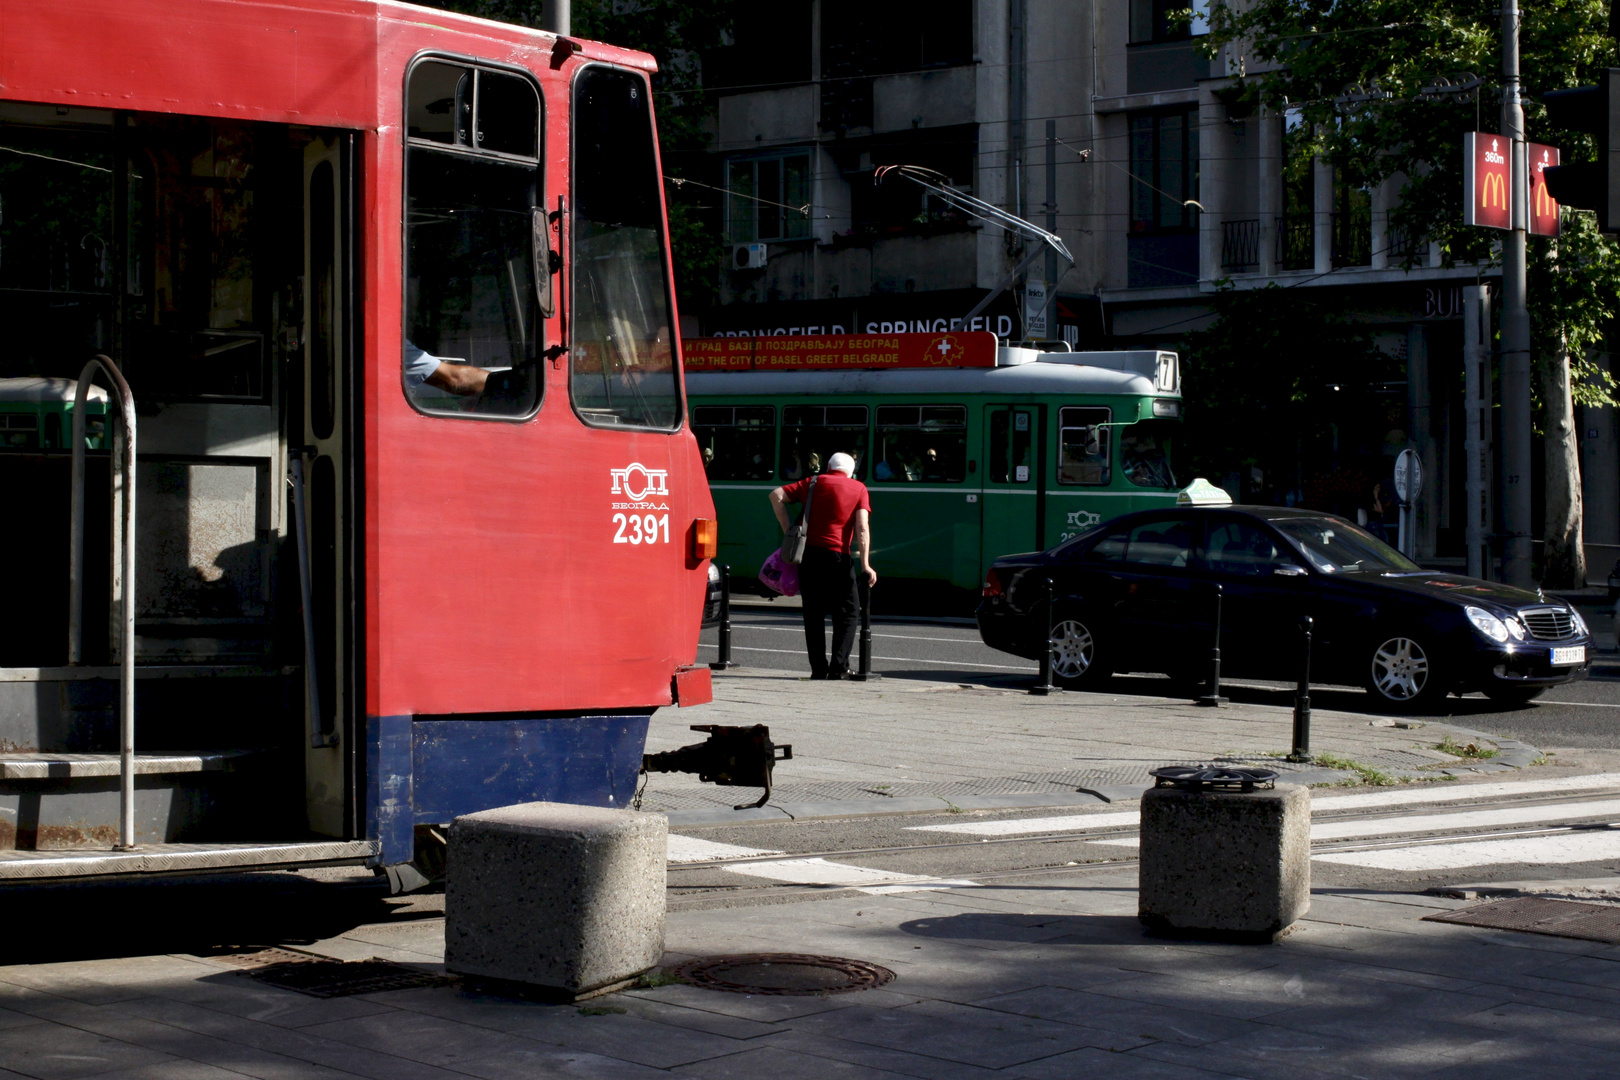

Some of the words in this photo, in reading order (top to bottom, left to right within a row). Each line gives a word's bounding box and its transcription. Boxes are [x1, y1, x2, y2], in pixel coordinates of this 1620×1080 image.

[1484, 151, 1505, 165] 360m
[695, 342, 722, 352] ГРАД
[848, 338, 899, 350] БЕОГРАД
[684, 356, 705, 366] AND
[708, 356, 727, 366] THE
[729, 355, 752, 366] CITY
[755, 355, 768, 365] OF
[770, 355, 803, 365] BASEL
[806, 354, 840, 364] GREET
[842, 353, 899, 364] BELGRADE
[1163, 359, 1169, 386] 7
[612, 512, 670, 545] 2391
